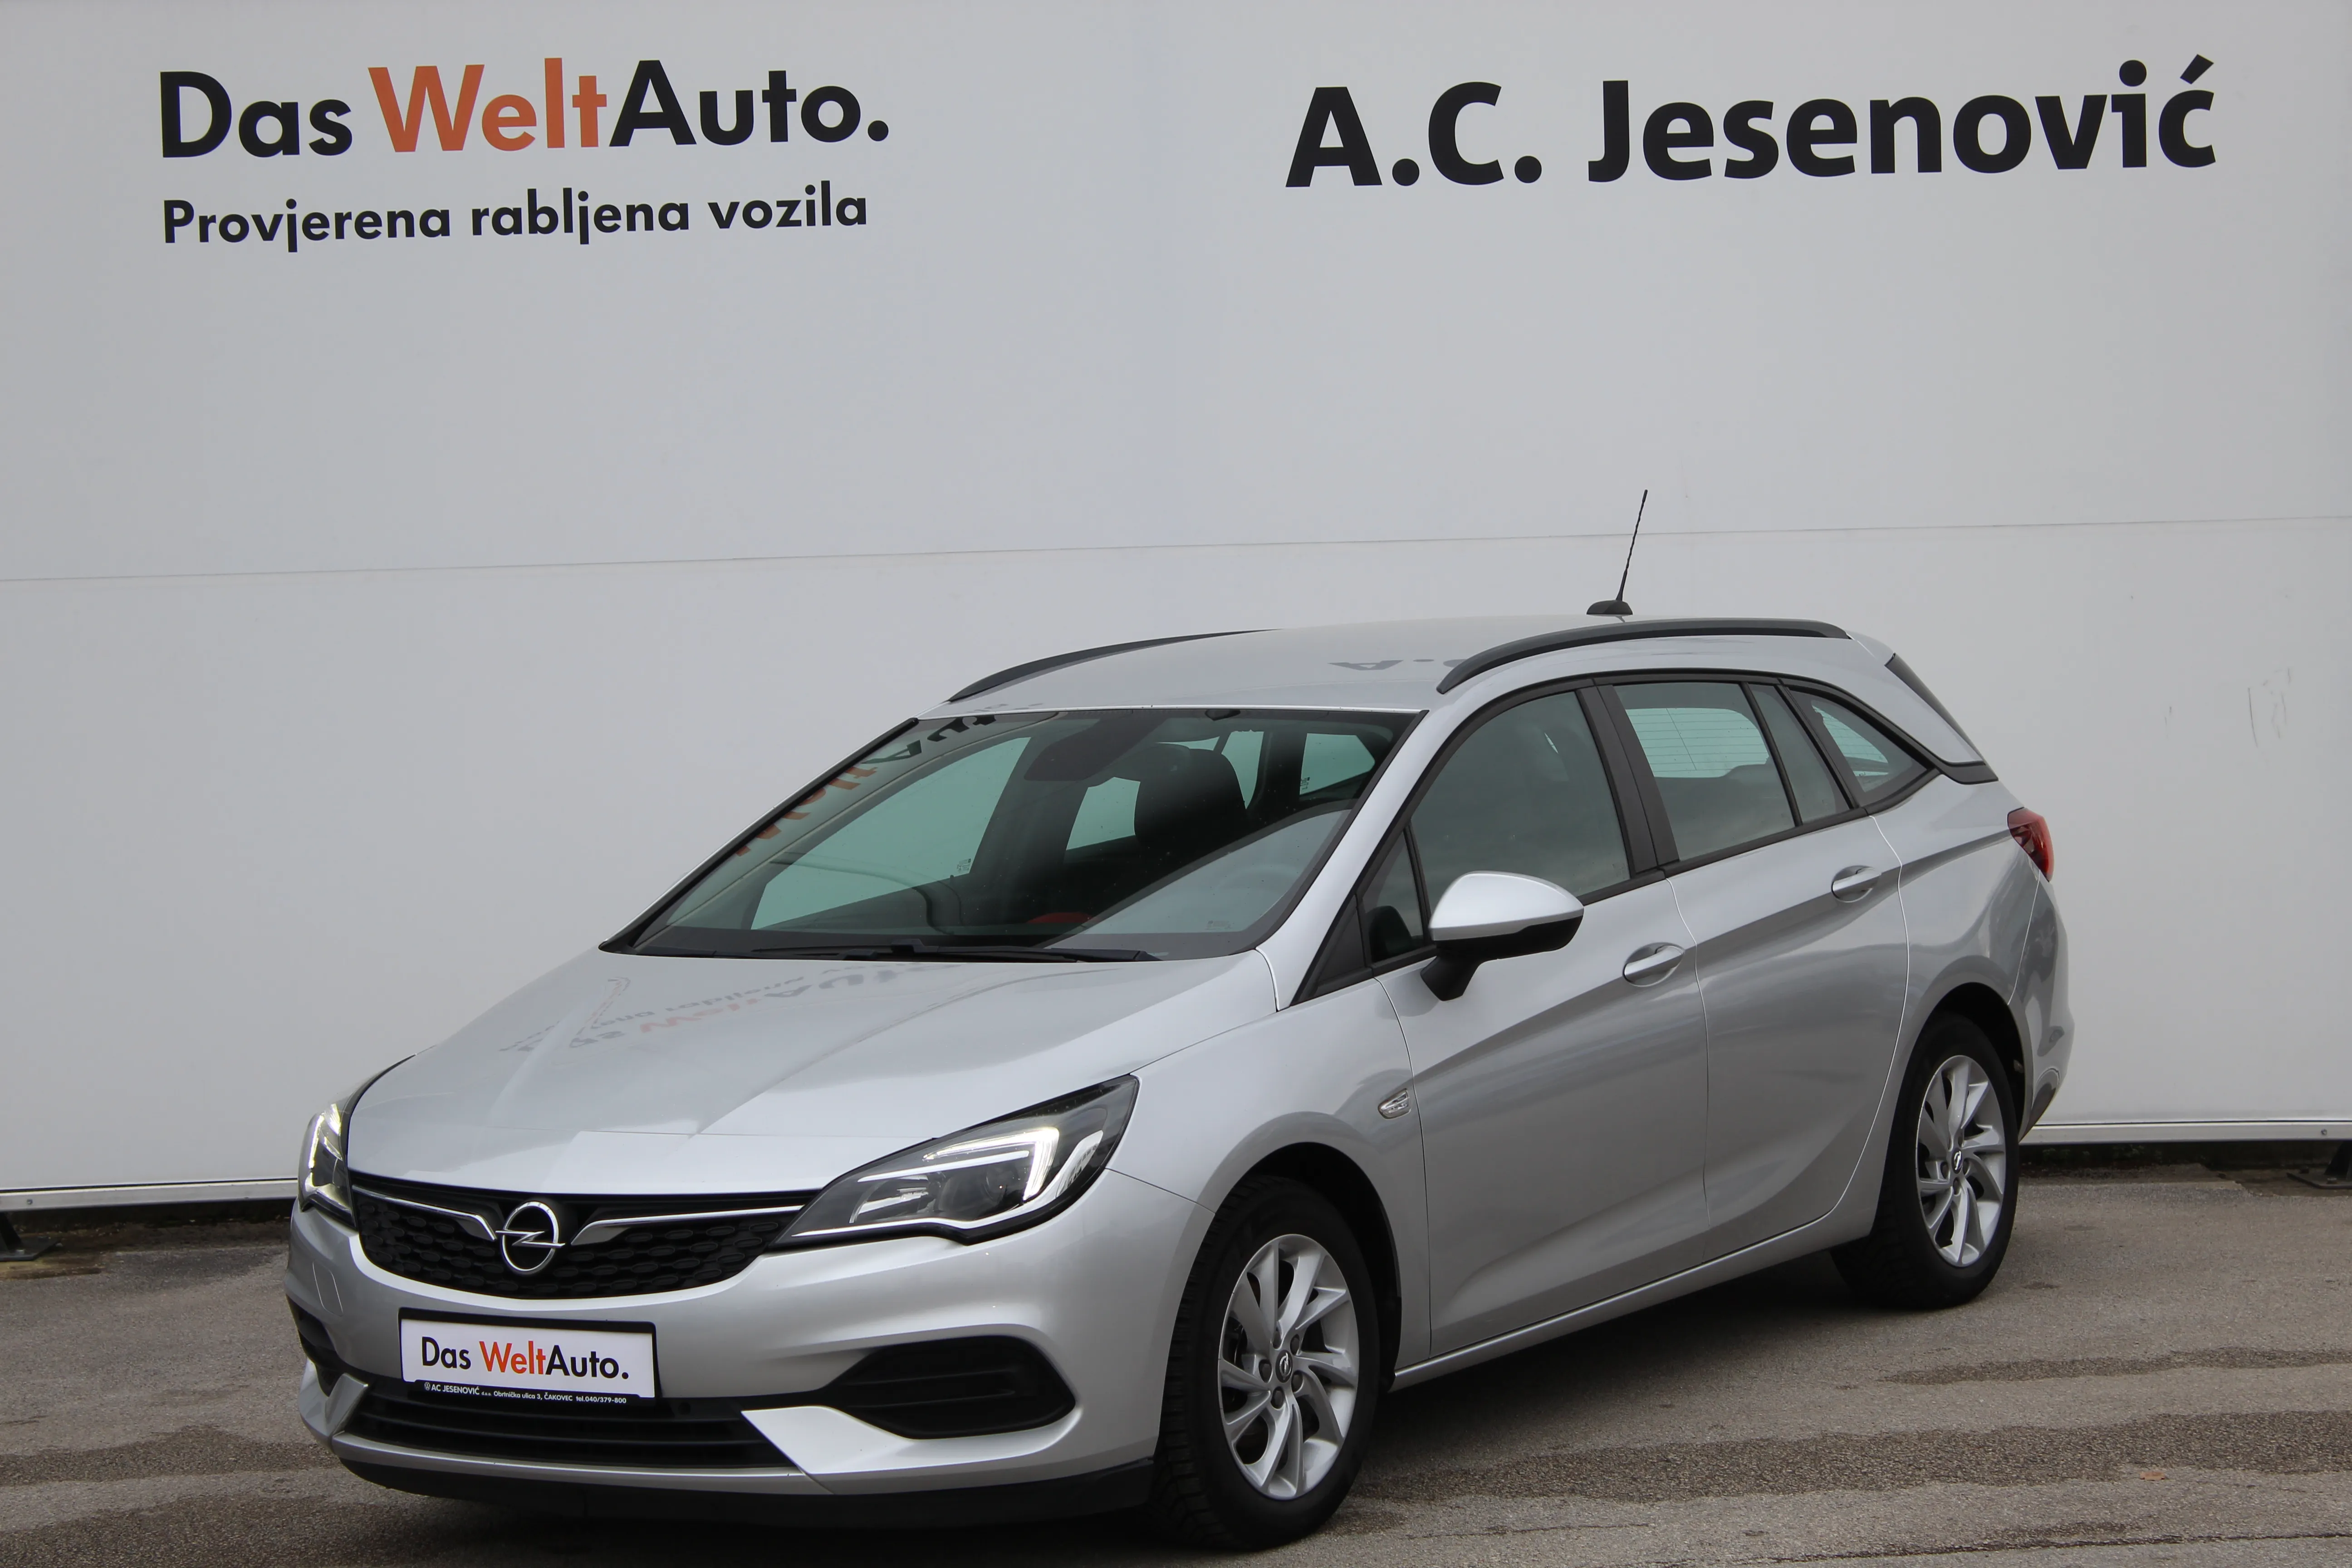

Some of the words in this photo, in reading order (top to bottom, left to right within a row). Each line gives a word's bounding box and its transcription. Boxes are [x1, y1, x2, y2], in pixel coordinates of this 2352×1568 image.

[160, 71, 353, 158] Das
[368, 57, 889, 152] WeltAuto.
[1285, 81, 1542, 187] A.C.
[1588, 54, 2216, 182] Jesenović
[163, 198, 450, 253] Provjerena
[472, 187, 689, 245] rabljena
[707, 180, 867, 229] vozila
[421, 1336, 471, 1370] Das
[479, 1341, 629, 1380] WeltAuto.
[442, 1385, 480, 1395] JESENOVIĆ
[544, 1392, 573, 1401] ČAKOVEC
[576, 1396, 627, 1404] tel.040/379-800
